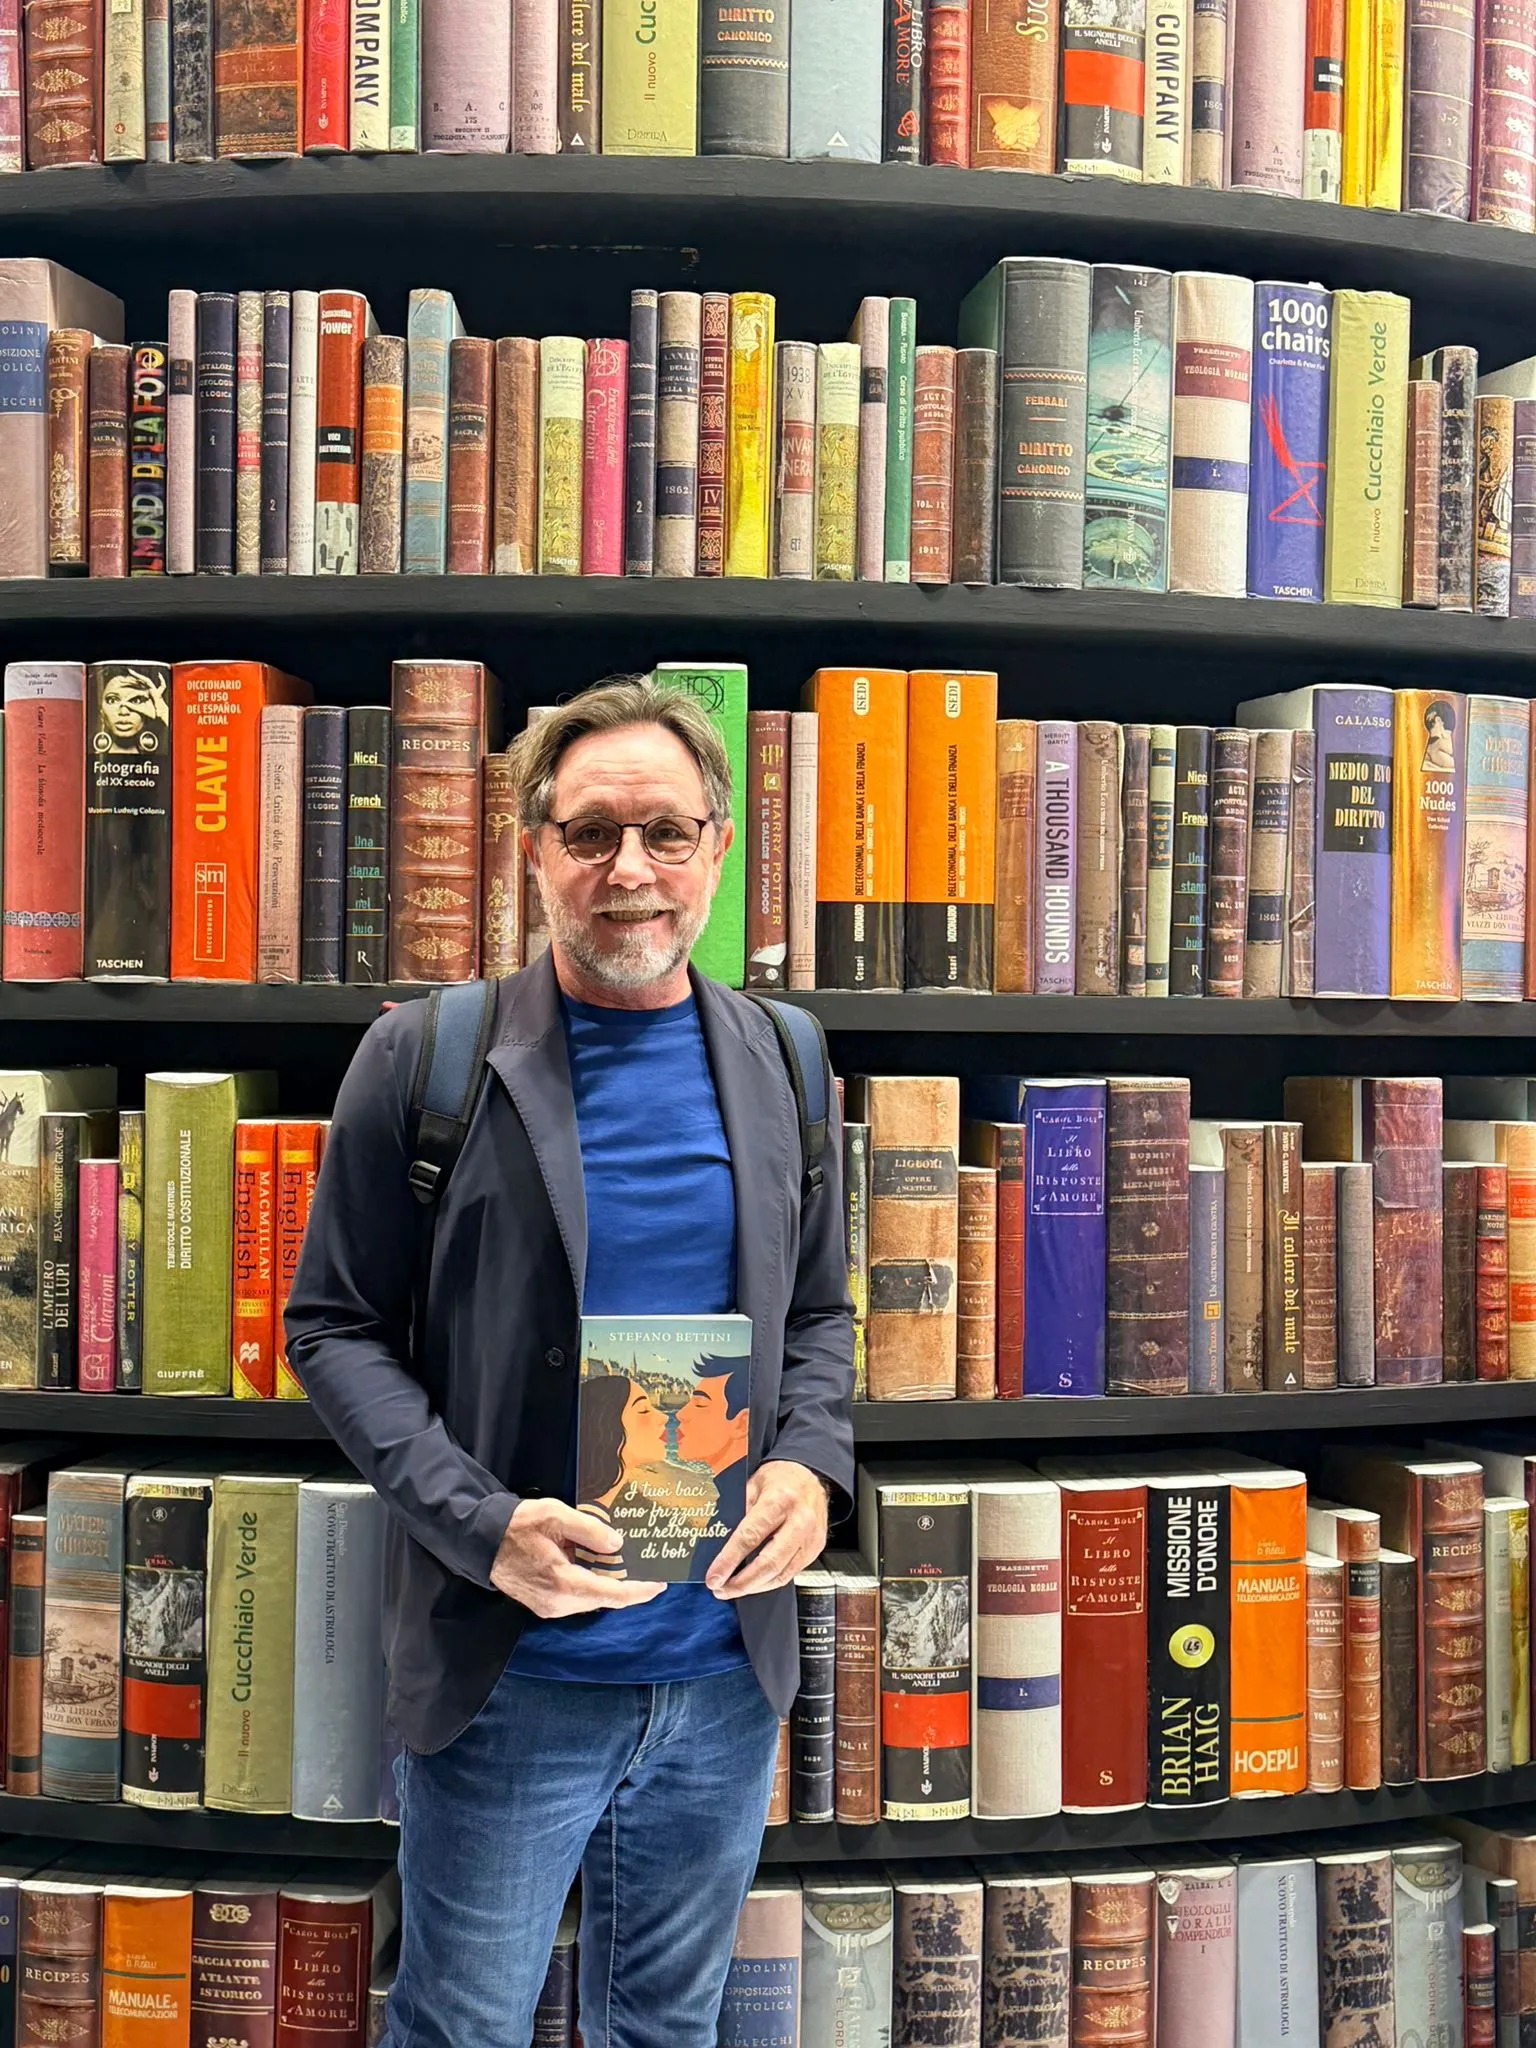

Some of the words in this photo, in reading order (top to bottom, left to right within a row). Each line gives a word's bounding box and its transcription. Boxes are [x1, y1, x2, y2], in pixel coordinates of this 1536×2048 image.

[718, 8, 775, 24] DIRITTO
[717, 31, 772, 44] CANONICO
[911, 8, 923, 68] LIBRO
[571, 41, 592, 66] del
[646, 51, 656, 89] nuovo
[1156, 14, 1179, 145] COMPANY
[571, 72, 590, 113] male
[644, 93, 656, 101] Il
[464, 102, 477, 113] A.
[1268, 298, 1329, 329] 1000
[320, 319, 352, 335] Power
[1133, 309, 1145, 347] Umberto
[1262, 326, 1330, 358] chairs
[1368, 321, 1387, 386] Verde
[1184, 366, 1222, 377] TEOLOGIA
[897, 406, 907, 428] diritto
[896, 429, 907, 461] pubblico
[1019, 441, 1074, 457] DIRITTO
[1364, 394, 1384, 502] Cucchiaio
[1017, 464, 1071, 477] CANONICO
[270, 500, 277, 511] 2
[703, 488, 721, 504] IV
[636, 500, 643, 513] 2
[1372, 508, 1381, 544] nuovo
[1370, 544, 1379, 553] Il
[1273, 585, 1313, 597] TASCHEN
[186, 680, 241, 691] DICCIONARIO
[198, 691, 209, 702] DE
[210, 692, 228, 703] USO
[187, 704, 202, 715] DEL
[203, 701, 241, 715] ESPAÑOL
[197, 715, 228, 726] ACTUAL
[1335, 714, 1392, 729] CALASSO
[402, 738, 471, 752] RECIPES
[353, 752, 378, 764] Nicci
[855, 742, 866, 770] FINANZA
[947, 744, 958, 772] FINANZA
[93, 761, 160, 777] Fotografia
[1045, 759, 1070, 774] A
[1328, 761, 1369, 780] MEDIO
[1373, 764, 1391, 783] EVO
[96, 777, 109, 787] del
[109, 778, 123, 787] XX
[124, 778, 155, 788] secolo
[195, 735, 227, 832] CLAVE
[855, 771, 866, 791] DELLA
[947, 772, 958, 793] DELLA
[1187, 771, 1207, 783] Nicci
[1350, 785, 1375, 804] DEL
[1425, 780, 1454, 796] 1000
[350, 793, 381, 807] French
[855, 797, 865, 819] BANCA
[1419, 797, 1456, 813] Nudes
[113, 807, 139, 816] Ludwig
[139, 807, 166, 816] Colonia
[947, 799, 958, 822] BANCA
[1182, 811, 1209, 826] French
[1334, 808, 1386, 830] DIRITTO
[772, 797, 782, 854] HARRY
[855, 820, 865, 840] DELLA
[947, 822, 957, 842] DELLA
[1045, 777, 1070, 880] THOUSAND
[354, 836, 373, 847] Una
[761, 821, 770, 861] CALICE
[349, 864, 379, 876] stanza
[761, 863, 769, 875] DI
[855, 843, 865, 896] DELL'ECONOMIA,
[355, 897, 371, 909] nel
[761, 878, 770, 915] FUOCO
[772, 861, 782, 926] POTTER
[352, 922, 374, 934] buio
[854, 904, 865, 942] DIZIONARIO
[1044, 888, 1069, 965] HOUNDS
[96, 958, 143, 969] TASCHEN
[854, 955, 864, 981] Cesari
[946, 955, 957, 980] Cesari
[1415, 979, 1453, 991] TASCHEN
[1048, 1146, 1092, 1158] LIBRO
[180, 1129, 192, 1224] COSTITUZIONALE
[1035, 1174, 1102, 1187] RISPOSTE
[53, 1165, 65, 1243] JEAN-CHRISTOPHE
[236, 1170, 256, 1281] English
[259, 1171, 271, 1281] MACMILLAN
[180, 1225, 192, 1269] DIRITTO
[1283, 1236, 1299, 1285] colore
[55, 1262, 70, 1297] LUPI
[42, 1260, 55, 1330] L'IMPERO
[127, 1258, 136, 1322] POTTER
[1283, 1288, 1300, 1311] del
[55, 1298, 69, 1328] DEI
[93, 1273, 116, 1343] Citazioni
[609, 1331, 671, 1344] STEFANO
[676, 1332, 731, 1344] BETTINI
[1283, 1316, 1300, 1354] male
[156, 1367, 204, 1379] GIUFFRÈ
[642, 1484, 672, 1497] tuoi
[675, 1482, 708, 1498] baci
[326, 1502, 336, 1537] NUOVO
[614, 1504, 648, 1519] sono
[648, 1501, 719, 1526] frizzanti
[1076, 1517, 1110, 1528] CAROL
[629, 1526, 651, 1538] un
[652, 1520, 731, 1546] retrogusto
[236, 1511, 258, 1580] Verde
[641, 1541, 659, 1559] di
[661, 1541, 690, 1559] boh
[1083, 1548, 1131, 1560] LIBRO
[1166, 1496, 1192, 1598] MISSIONE
[1197, 1499, 1218, 1592] D'ONORE
[1432, 1542, 1483, 1558] RECIPES
[326, 1538, 336, 1588] TRATTATO
[987, 1582, 1027, 1594] TEOLOGIA
[1031, 1581, 1059, 1593] MORALE
[1070, 1574, 1141, 1587] RISPOSTE
[1237, 1577, 1296, 1593] MANUALE
[325, 1603, 335, 1664] ASTROLOGIA
[231, 1588, 254, 1702] Cucchiaio
[902, 1672, 934, 1682] SIGNORE
[936, 1671, 960, 1680] DEGLI
[911, 1679, 941, 1688] ANELLI
[241, 1709, 251, 1747] nuovo
[1161, 1695, 1192, 1797] BRIAN
[1194, 1702, 1220, 1785] HAIG
[1234, 1747, 1298, 1774] HOEPLI
[1278, 1875, 1289, 1911] NUOVO
[1278, 1913, 1289, 1961] TRATTATO
[192, 1955, 270, 1969] CACCIATORE
[293, 1959, 342, 1974] LIBRO
[1083, 1957, 1146, 1972] RECIPES
[24, 1967, 90, 1984] RECIPES
[199, 1973, 261, 1985] ATLANTE
[108, 1989, 171, 2009] MANUALE
[200, 1988, 262, 2001] ISTORICO
[283, 1986, 355, 2003] RISPOSTE
[724, 1985, 793, 1996] OPPOSIZIONE
[108, 2004, 178, 2019] TELECOMUNICAZIONI
[1278, 1976, 1288, 2037] ASTROLOGIA
